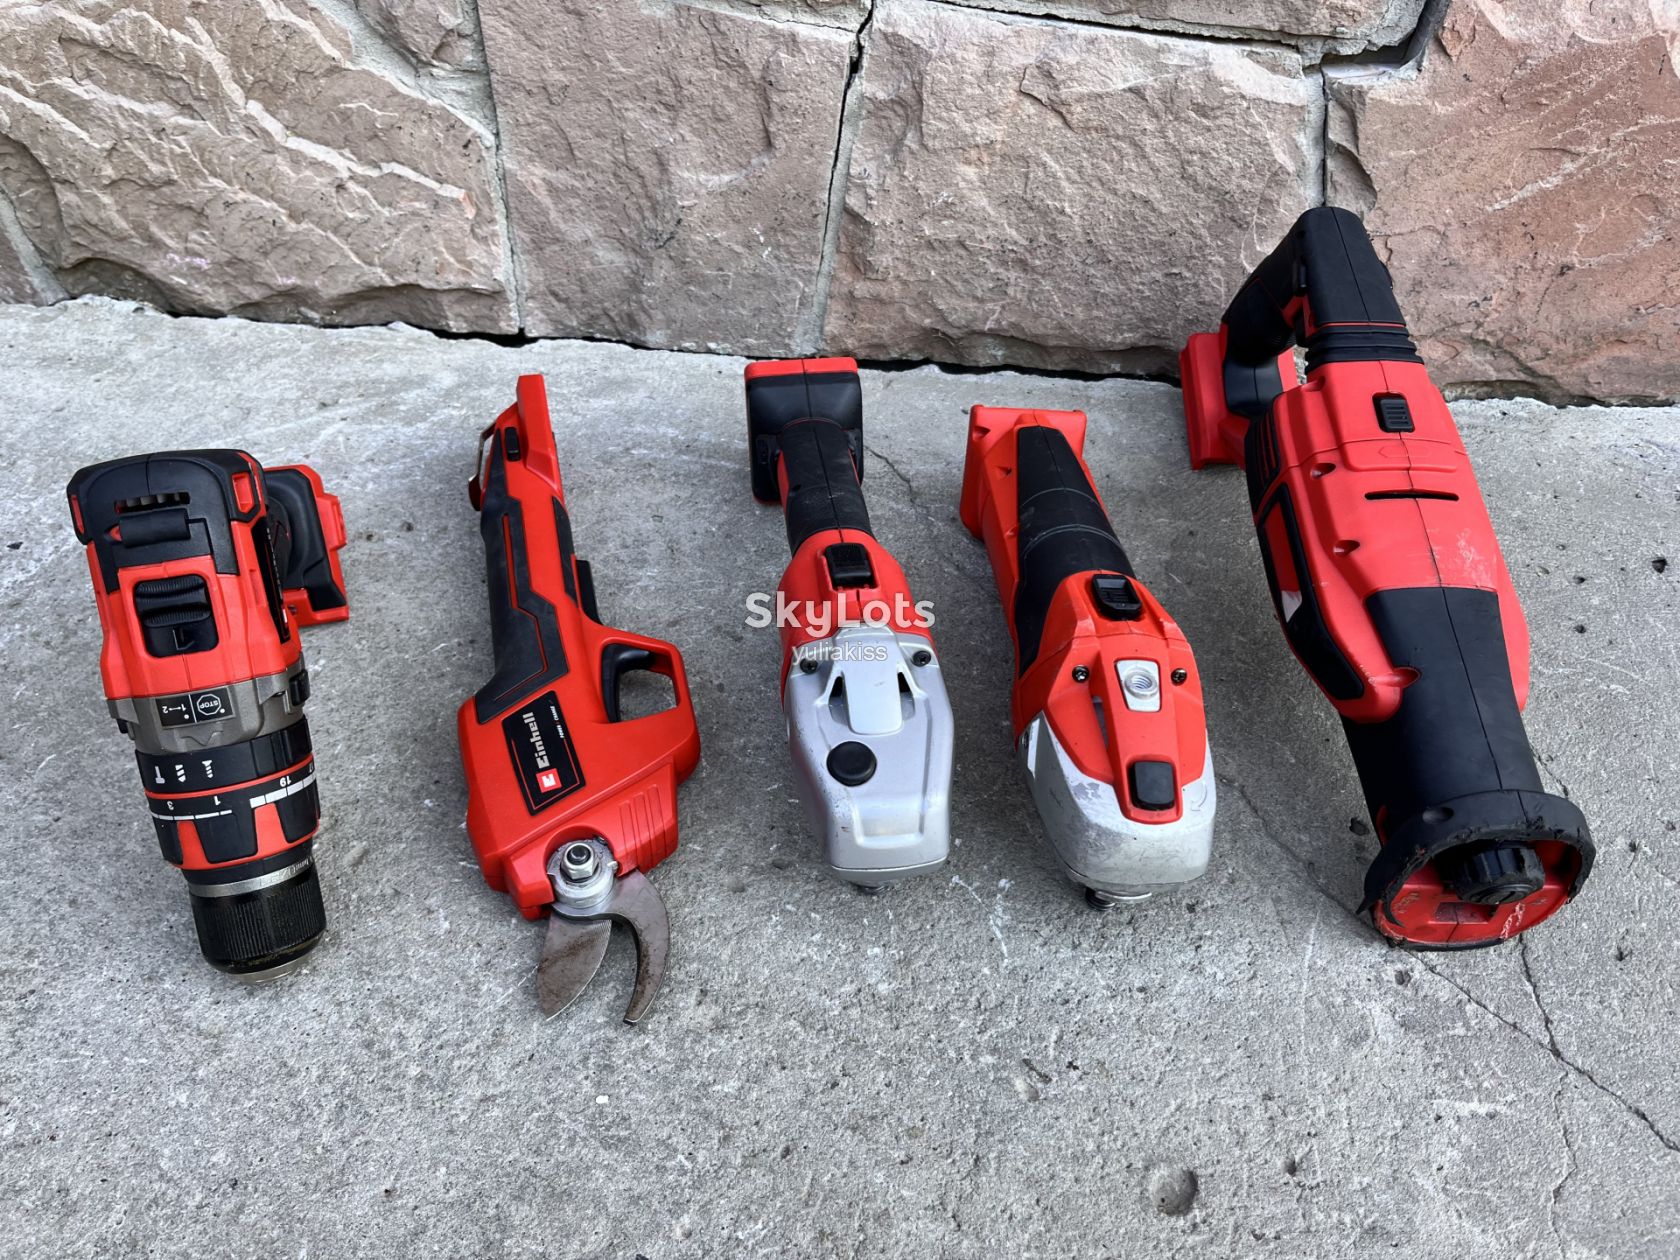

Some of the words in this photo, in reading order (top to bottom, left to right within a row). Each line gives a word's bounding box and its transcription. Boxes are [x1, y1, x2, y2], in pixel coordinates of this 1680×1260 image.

[162, 705, 169, 714] 2
[200, 700, 218, 709] STOP
[522, 711, 550, 769] Einhell
[279, 775, 292, 787] 19
[166, 800, 175, 811] 3
[213, 795, 221, 806] 1
